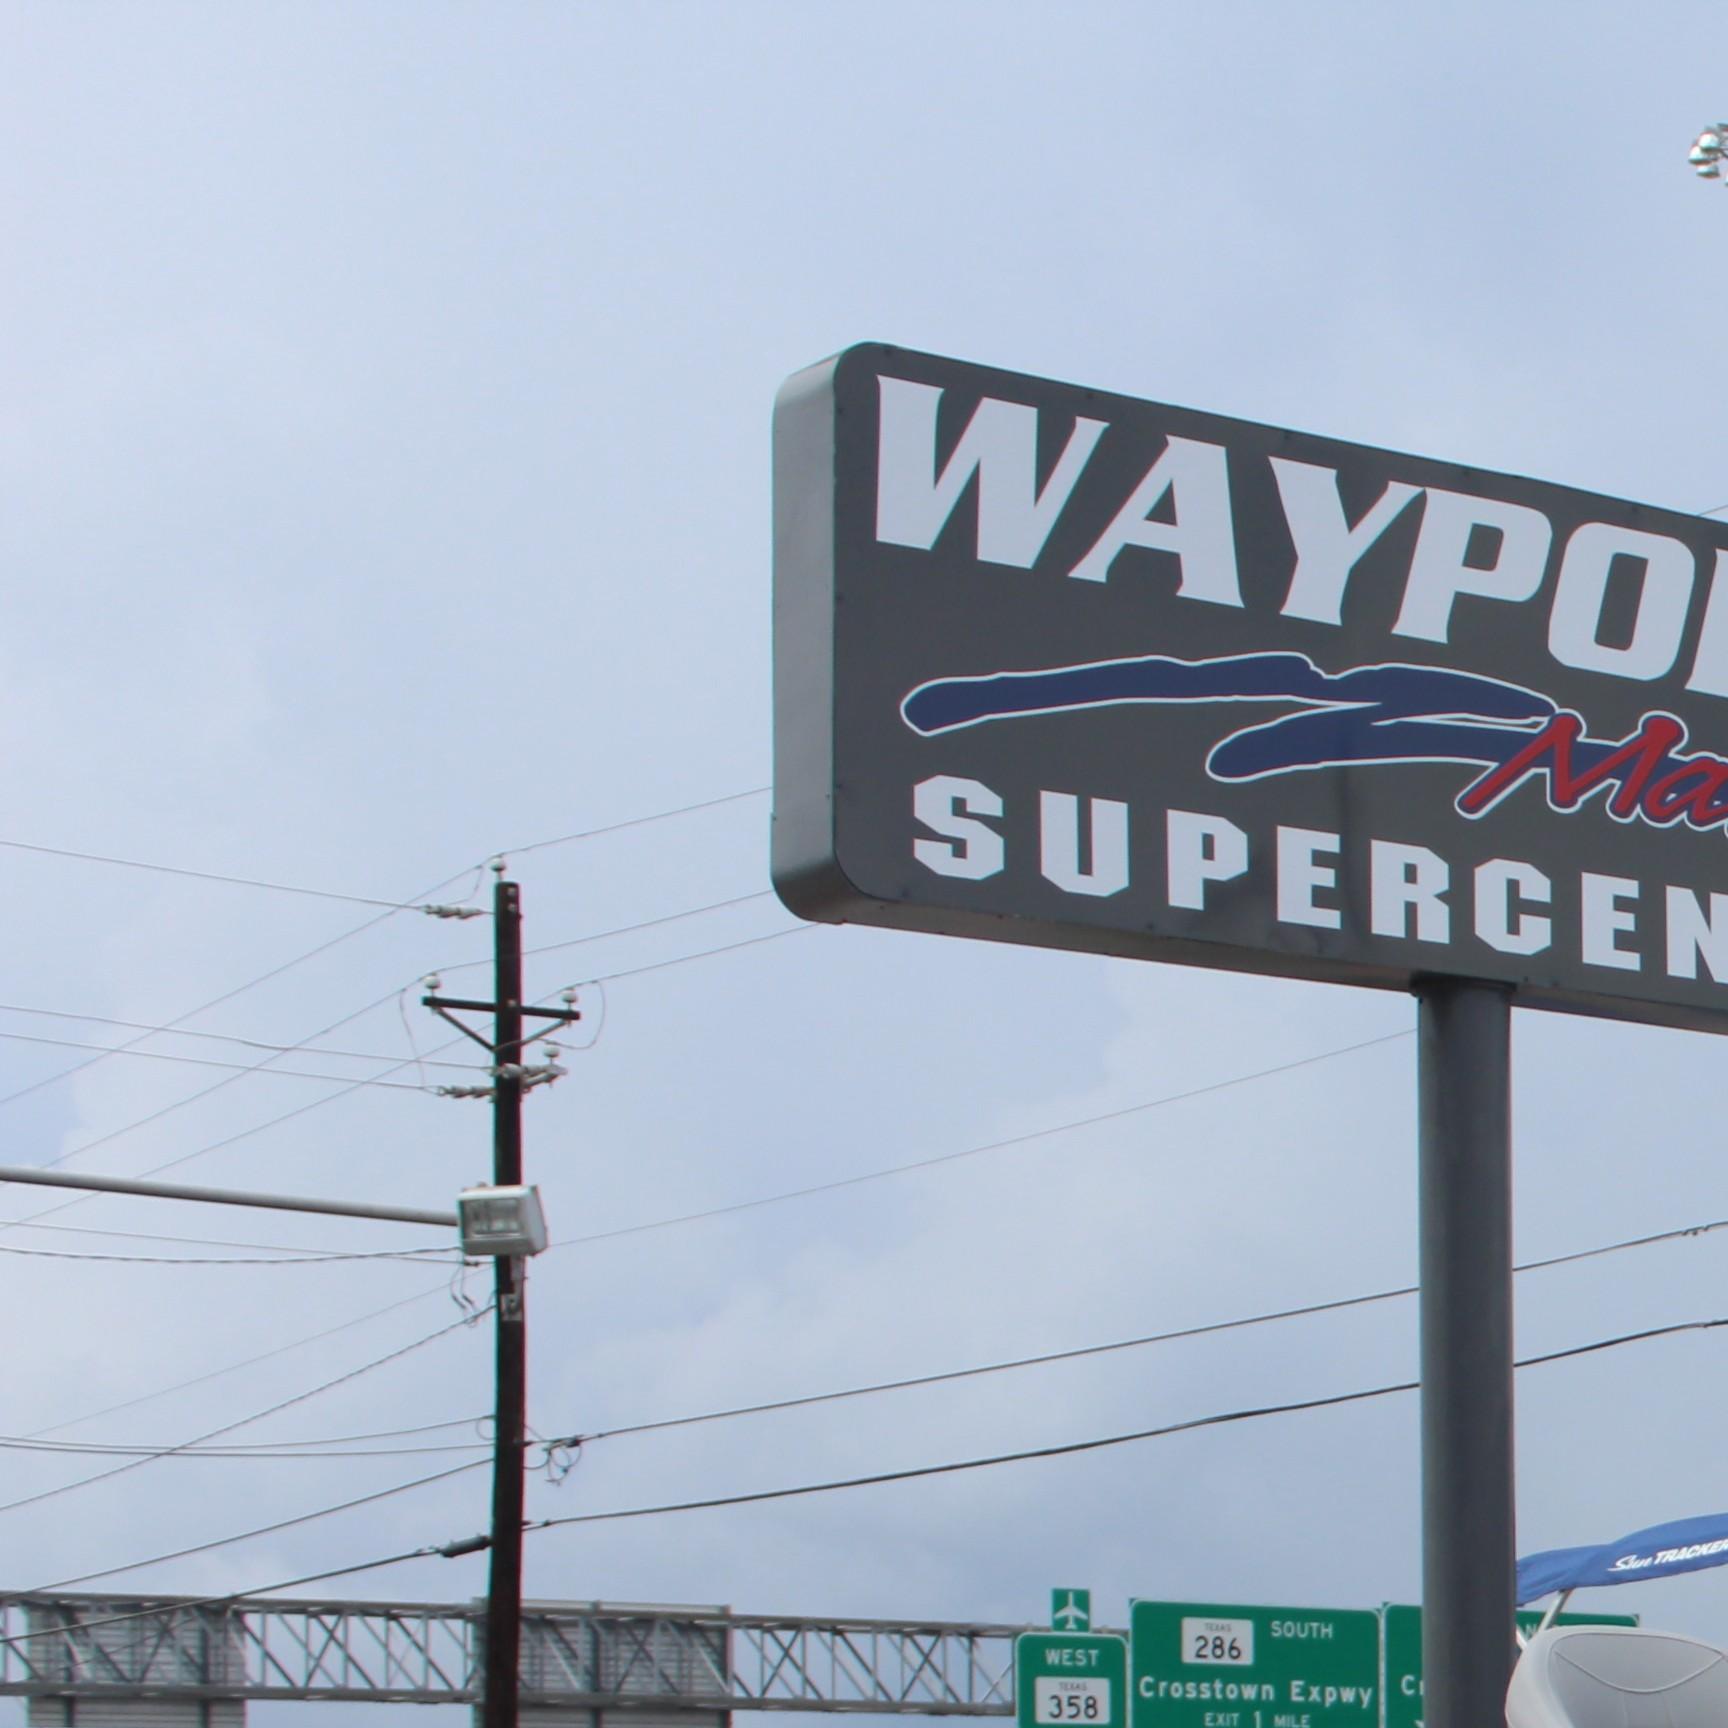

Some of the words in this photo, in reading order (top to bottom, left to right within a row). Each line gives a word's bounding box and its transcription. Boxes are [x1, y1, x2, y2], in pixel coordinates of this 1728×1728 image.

[1204, 1623, 1232, 1633] TEXAS
[1271, 1620, 1334, 1639] SOUTH
[1195, 1635, 1241, 1660] 286
[1045, 1649, 1099, 1666] WEST
[1059, 1682, 1087, 1692] TEXAS
[1139, 1676, 1275, 1701] Crosstown
[1290, 1680, 1373, 1709] Expwy
[1049, 1695, 1098, 1719] 358
[1204, 1712, 1240, 1727] EXIT
[1273, 1713, 1311, 1728] MILE
